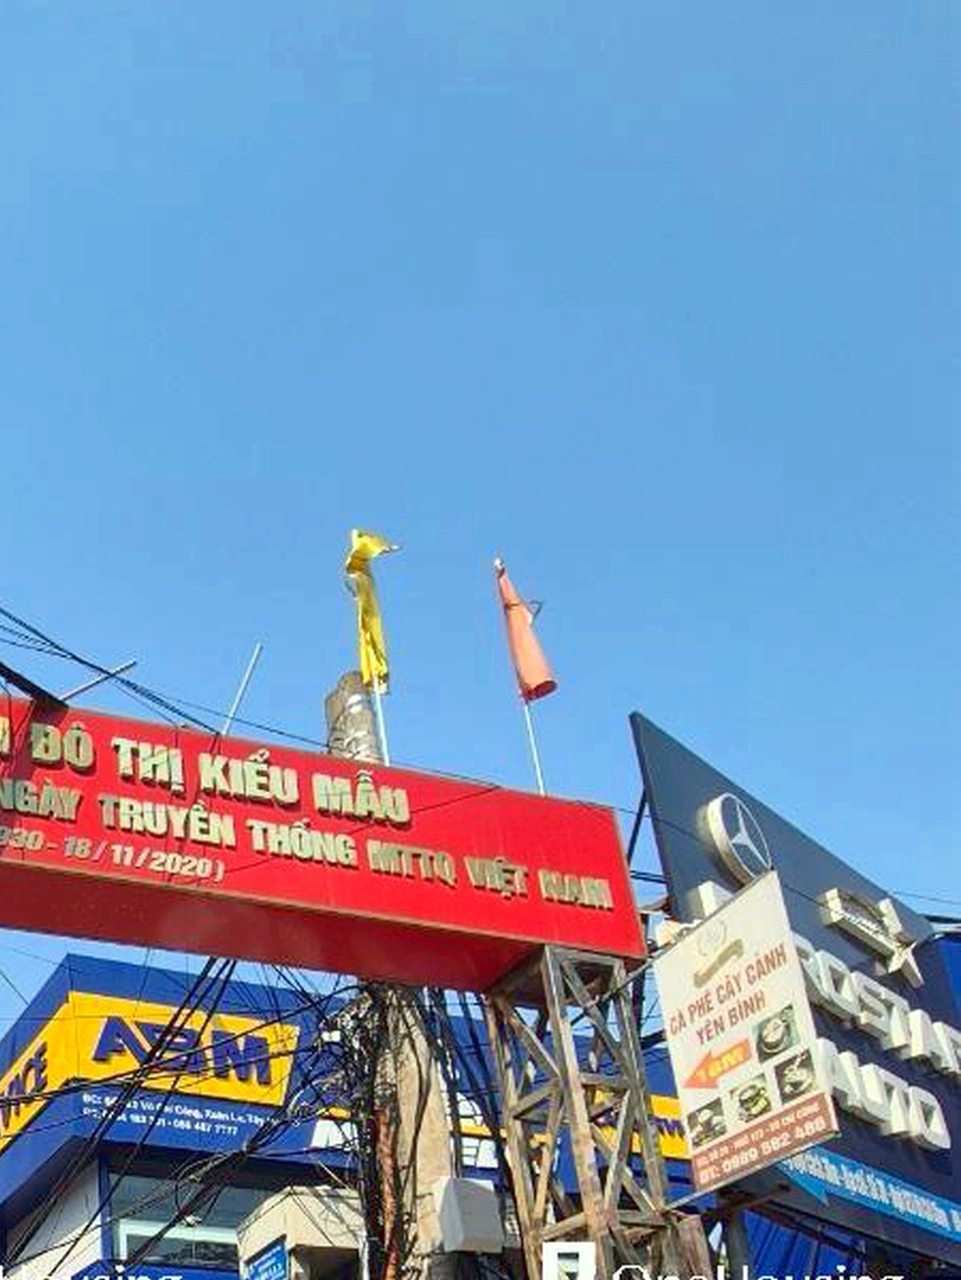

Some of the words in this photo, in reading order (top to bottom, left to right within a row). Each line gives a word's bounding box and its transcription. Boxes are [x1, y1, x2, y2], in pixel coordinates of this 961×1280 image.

[29, 721, 95, 769] ĐÔ
[111, 737, 185, 793] THỊ
[98, 794, 237, 848] TRUYỀN
[246, 818, 359, 868] THỐNG
[464, 855, 529, 899] VIỆT
[538, 868, 614, 911] NAM
